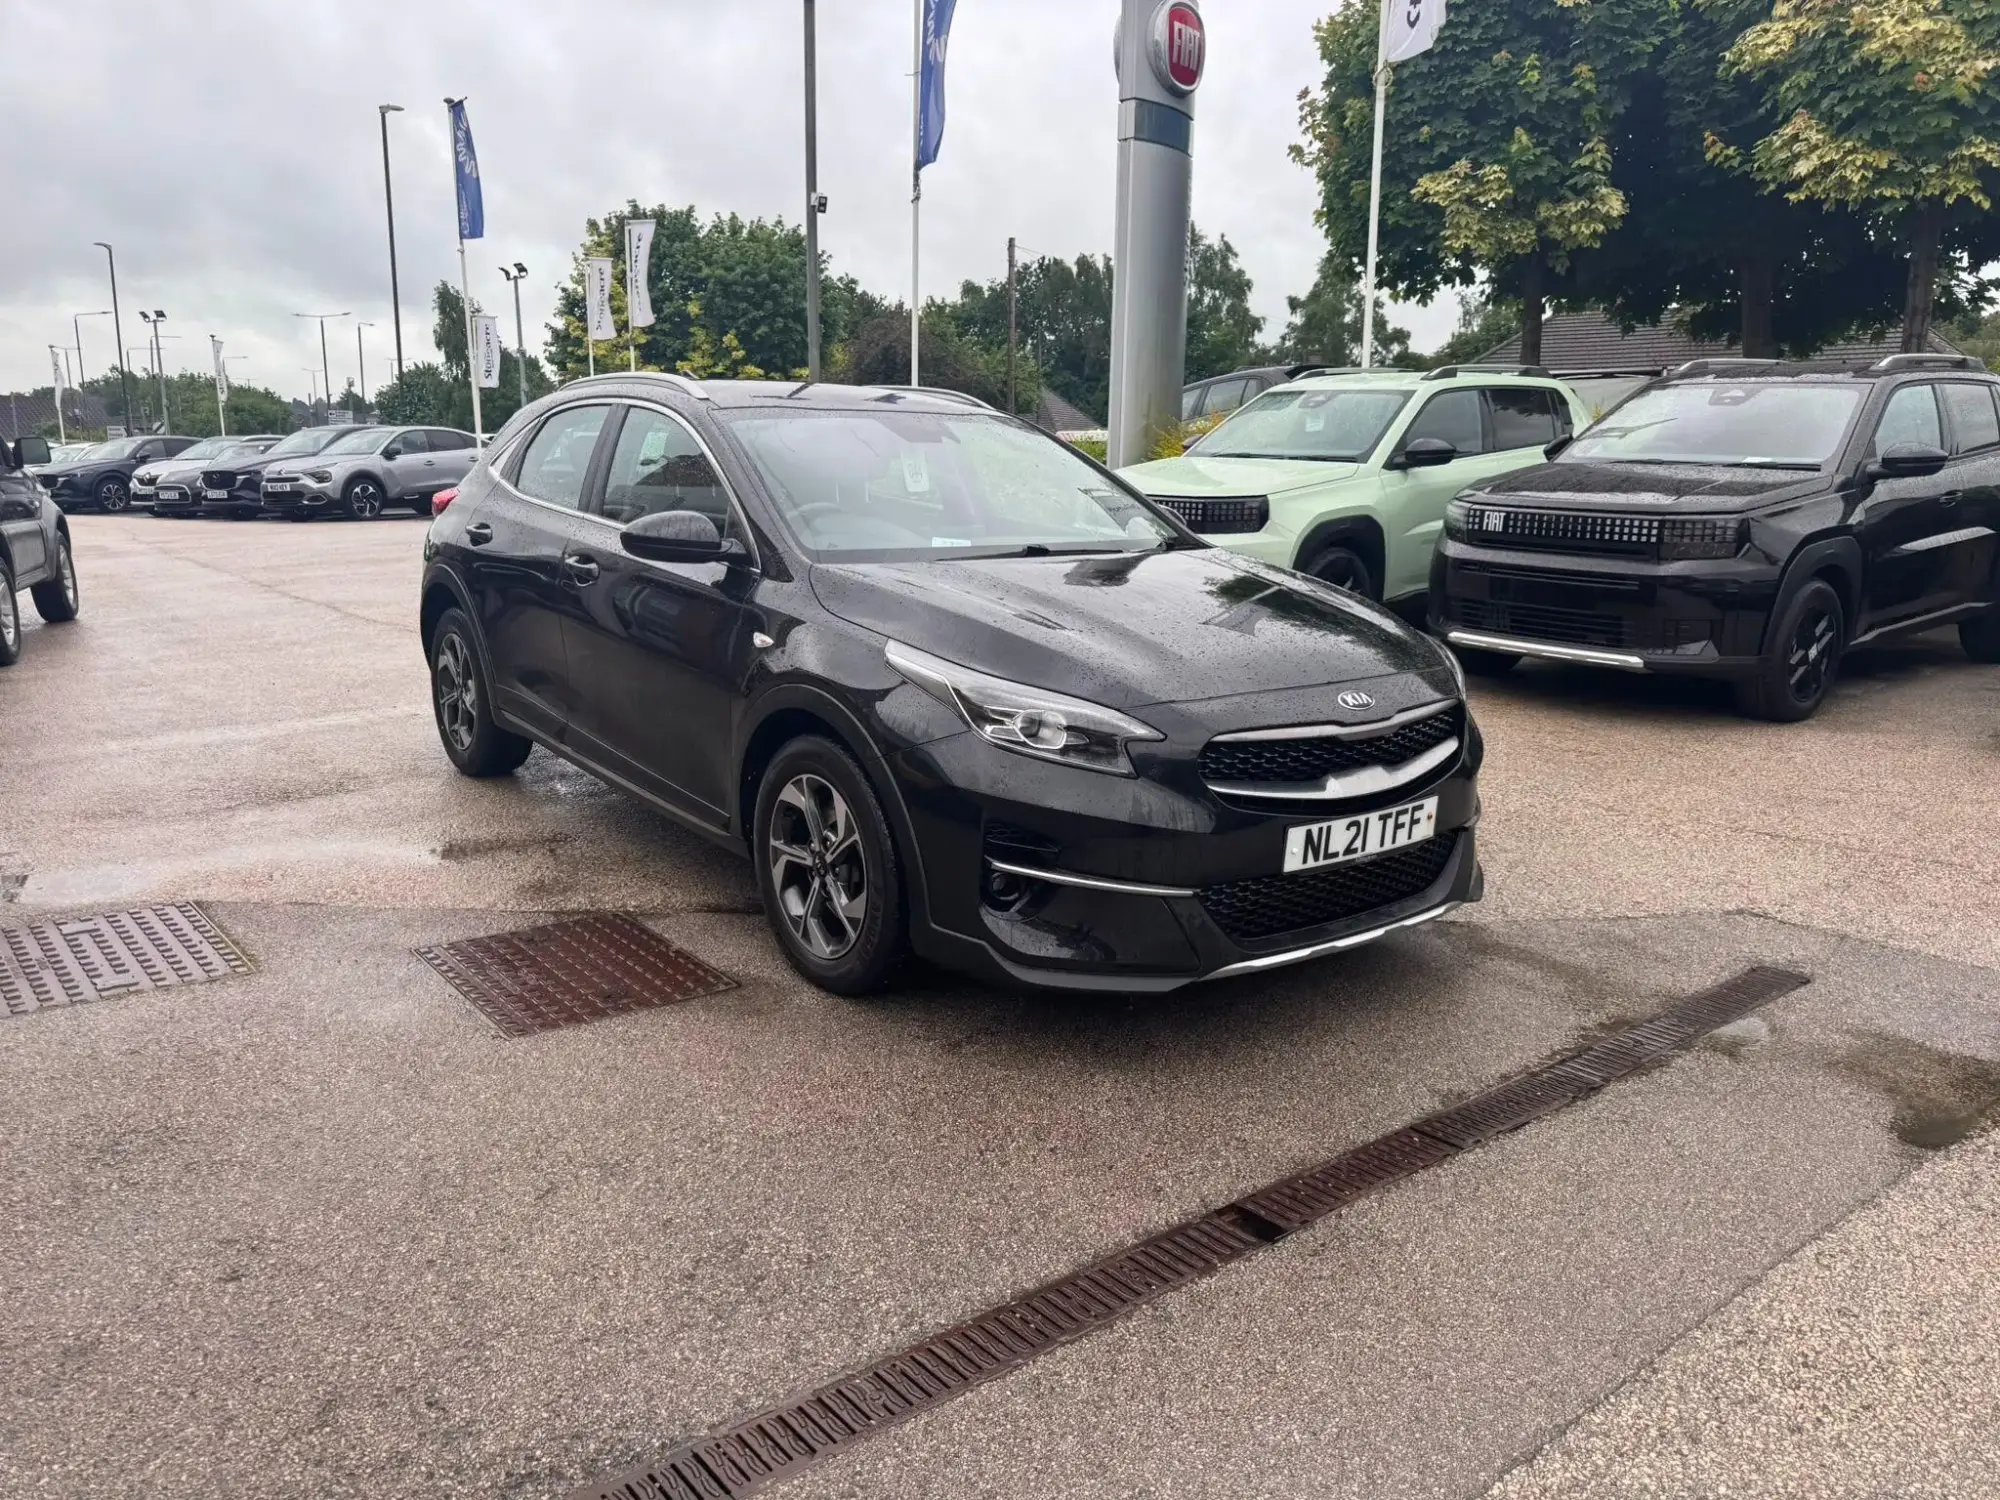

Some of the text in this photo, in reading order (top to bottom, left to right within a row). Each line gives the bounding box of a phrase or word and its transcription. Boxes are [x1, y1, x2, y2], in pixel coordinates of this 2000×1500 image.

[1173, 20, 1200, 71] FIAT
[1482, 510, 1506, 532] FIAT
[1342, 692, 1373, 706] KIA
[1302, 804, 1424, 865] NL21 TFF
